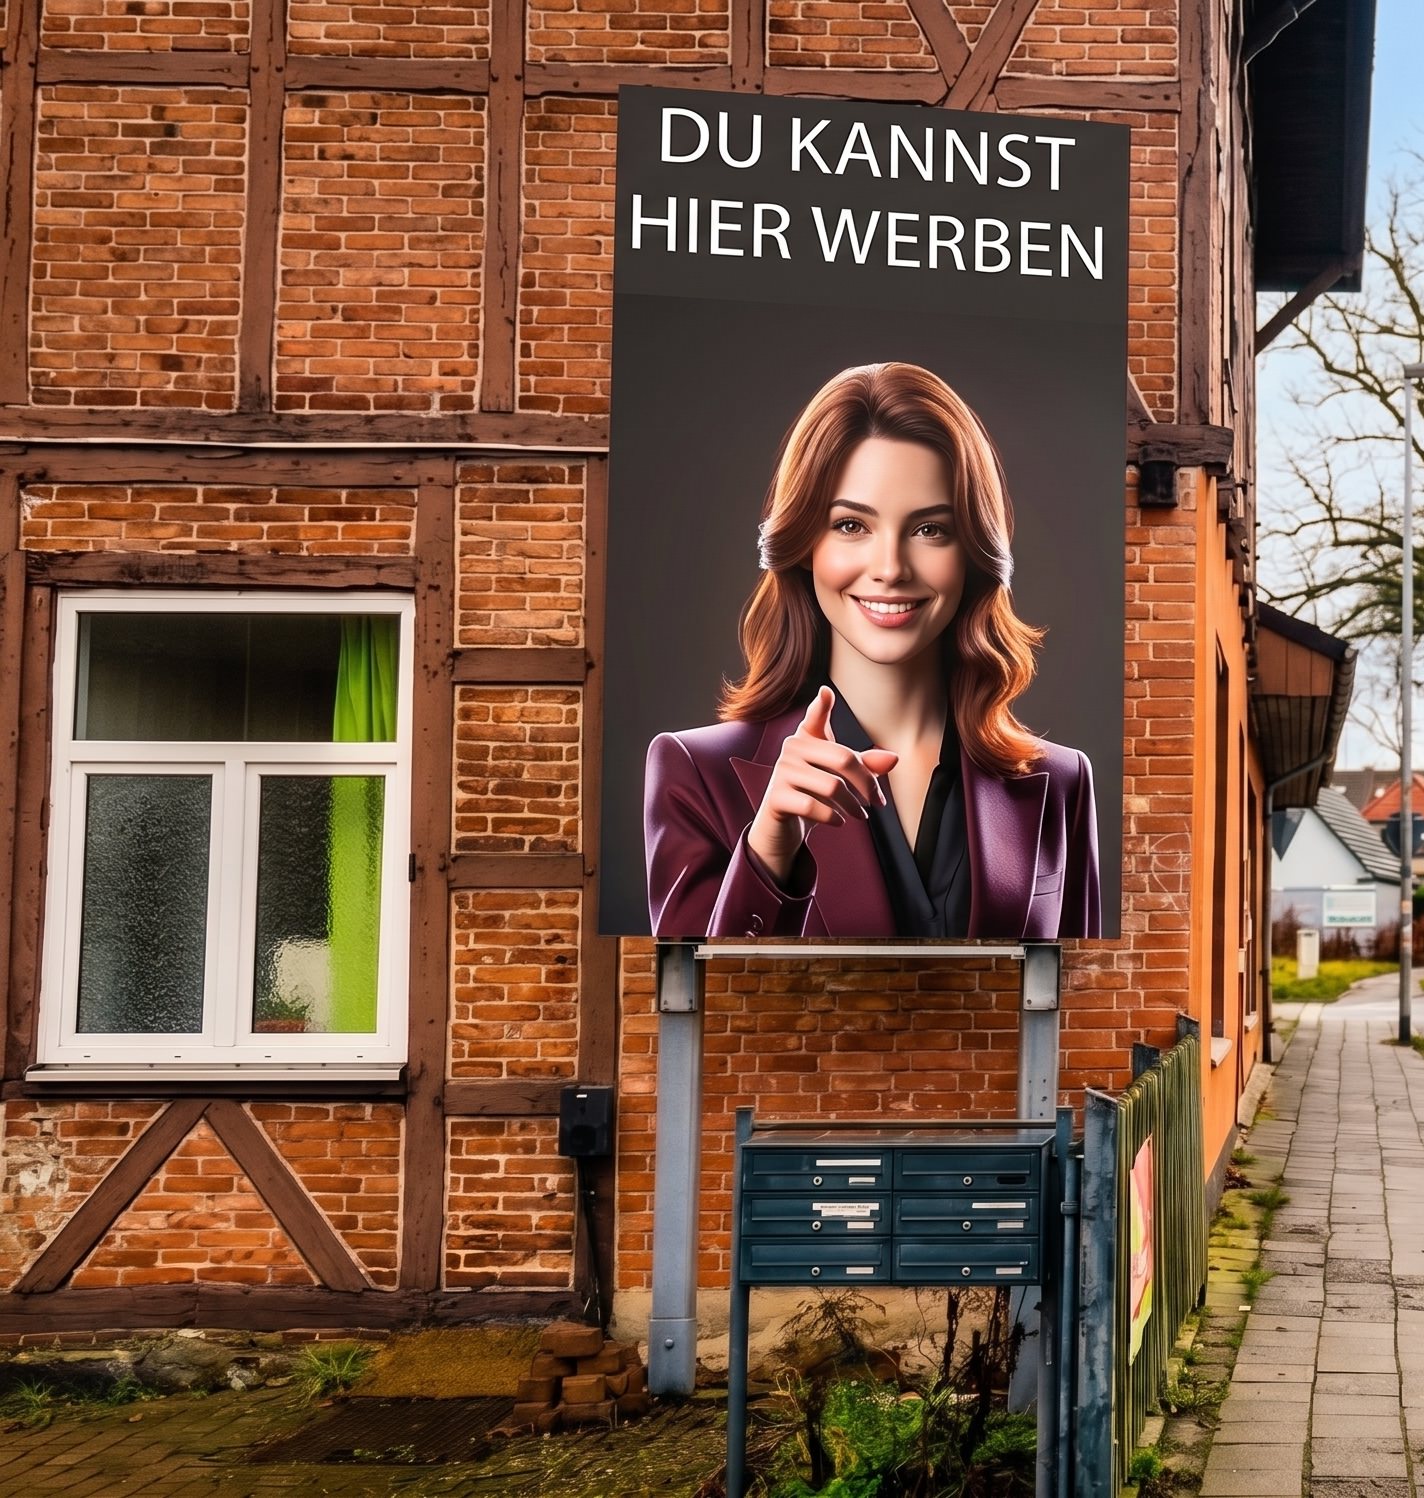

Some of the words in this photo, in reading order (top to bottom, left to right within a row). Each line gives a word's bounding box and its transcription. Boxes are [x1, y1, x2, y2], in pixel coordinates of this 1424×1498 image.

[661, 107, 762, 168] DU
[791, 117, 1076, 191] KANNST
[631, 194, 792, 260] HIER
[810, 206, 1103, 280] WERBEN
